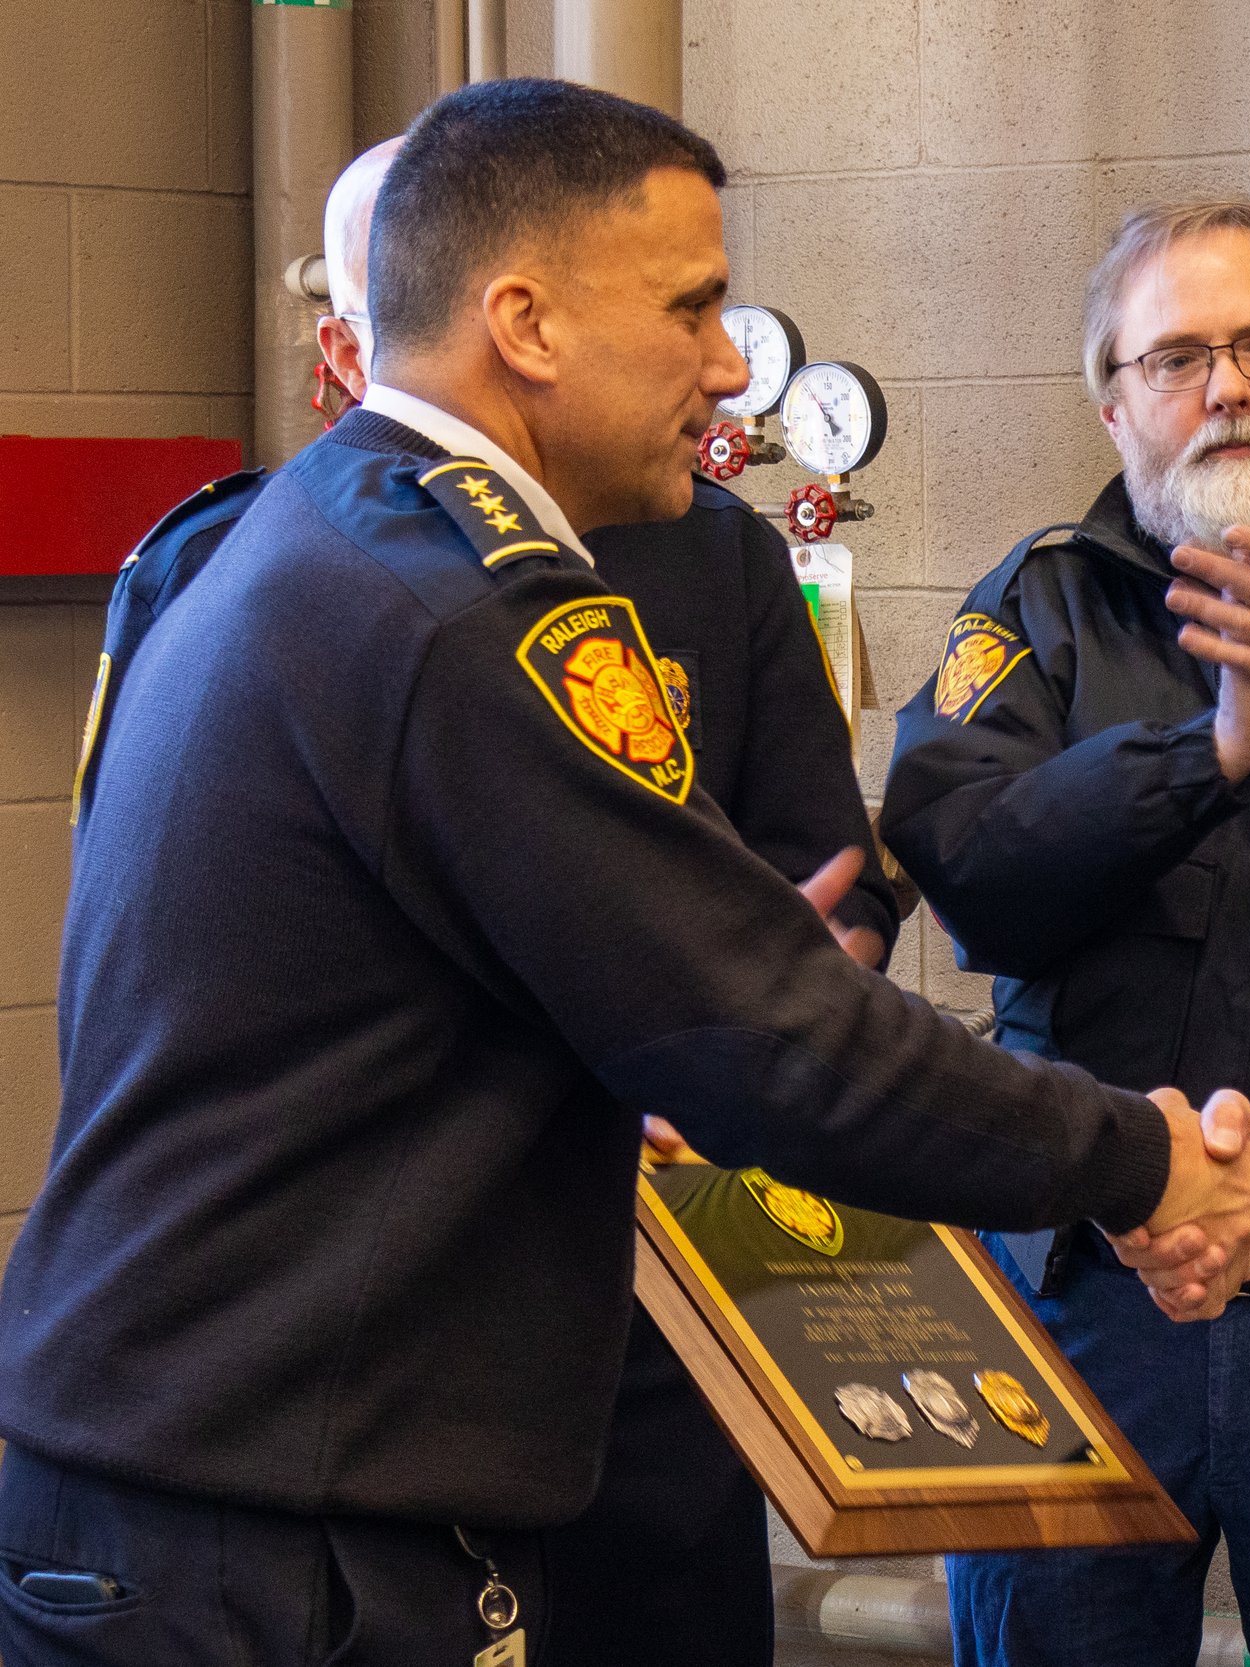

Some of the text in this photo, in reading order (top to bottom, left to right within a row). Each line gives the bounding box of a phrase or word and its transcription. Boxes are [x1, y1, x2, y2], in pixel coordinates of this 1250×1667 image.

[823, 382, 833, 391] 150
[540, 608, 612, 655] RALEIGH
[953, 619, 1020, 642] RALEIGH
[582, 646, 615, 670] FIRE
